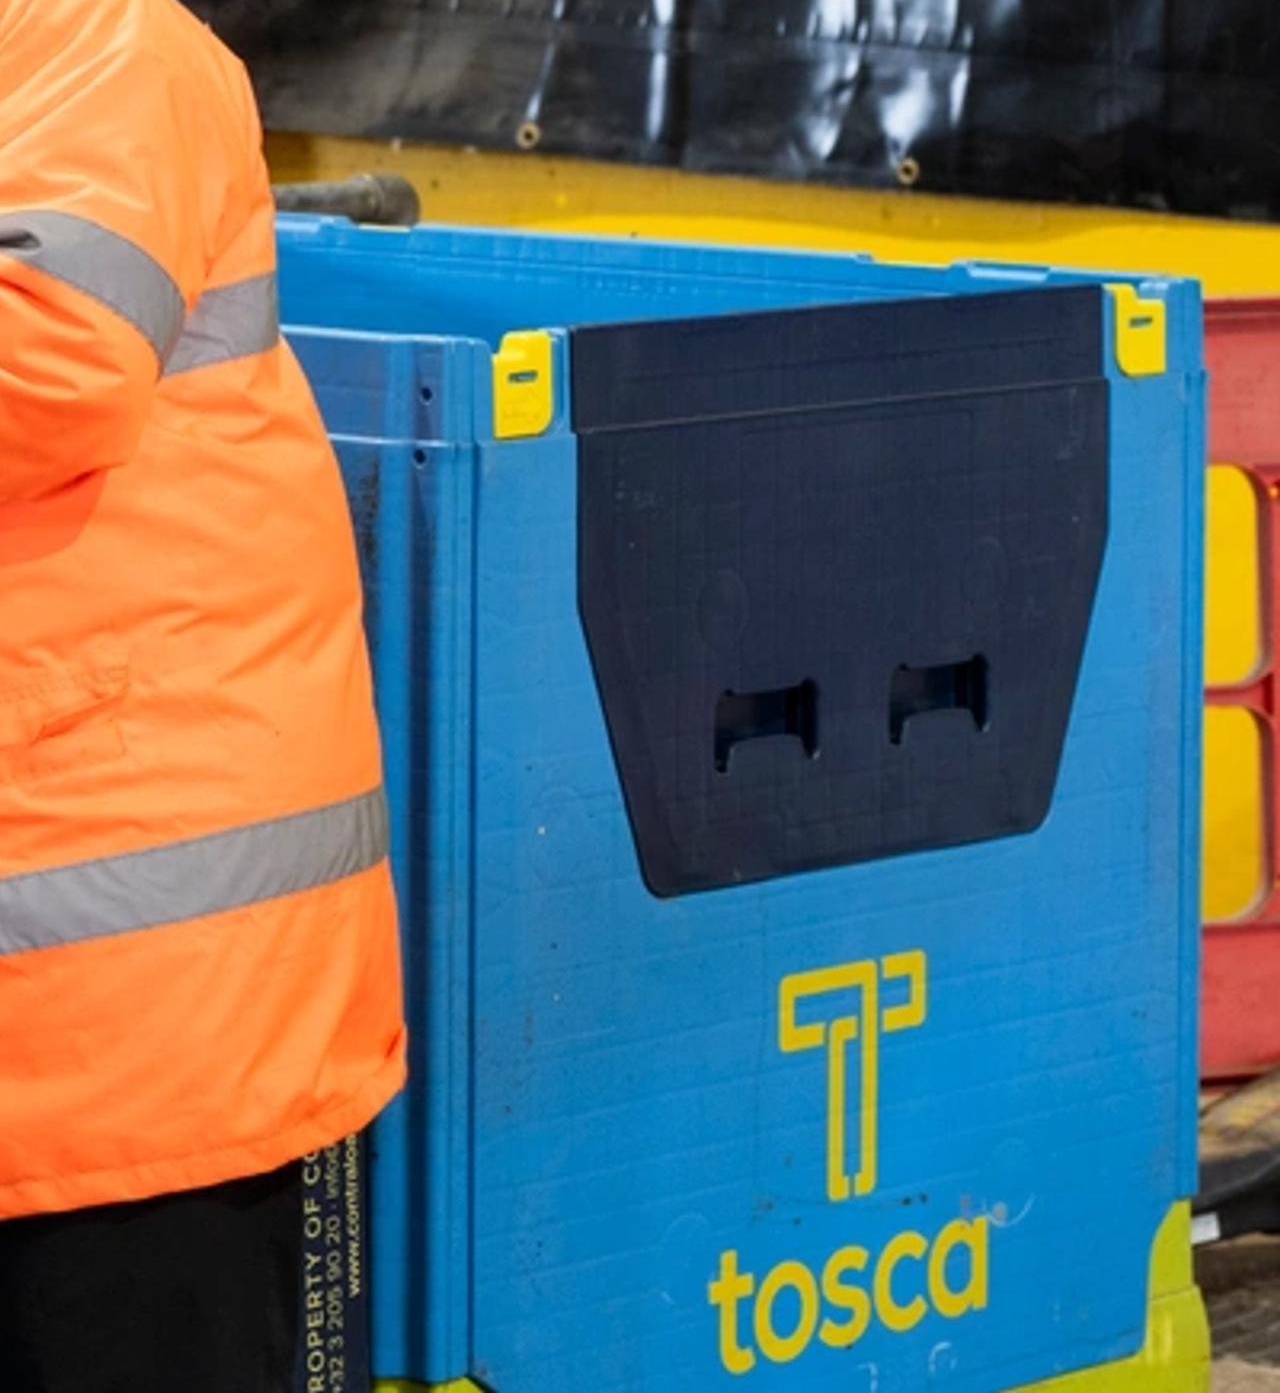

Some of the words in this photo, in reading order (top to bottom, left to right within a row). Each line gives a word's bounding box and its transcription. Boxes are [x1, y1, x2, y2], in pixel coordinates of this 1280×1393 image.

[304, 1197, 322, 1238] OF
[325, 1215, 341, 1246] 20
[342, 1133, 361, 1298] www.contraloa
[325, 1249, 342, 1282] 90
[325, 1287, 343, 1331] 205
[707, 1214, 989, 1376] tosca
[304, 1249, 326, 1393] ROPERTY
[326, 1334, 344, 1351] 3
